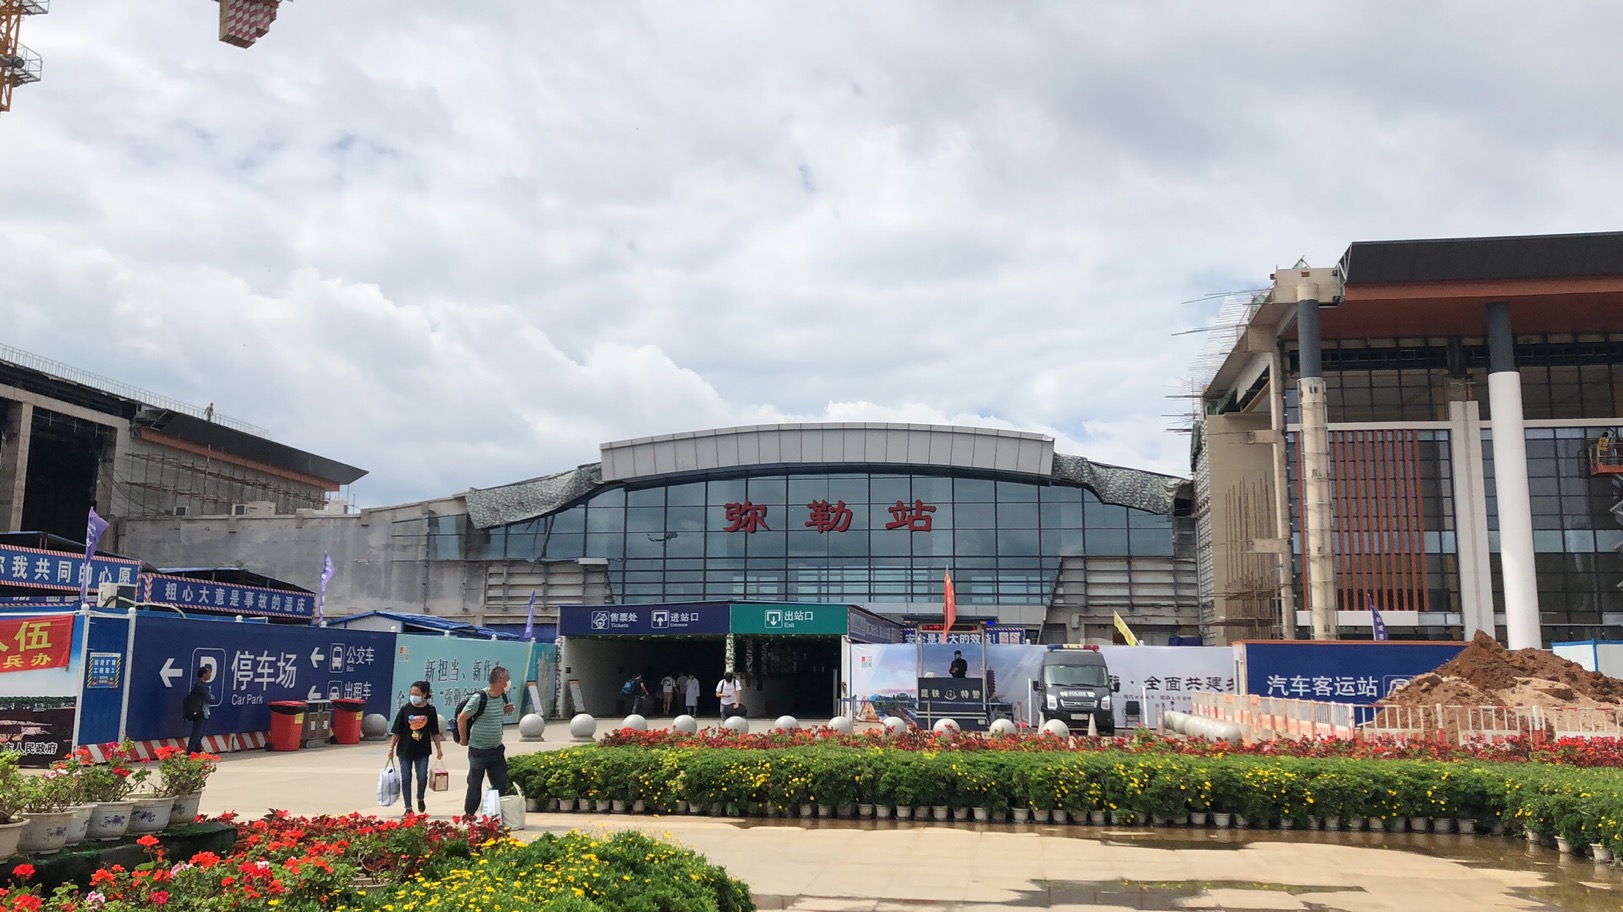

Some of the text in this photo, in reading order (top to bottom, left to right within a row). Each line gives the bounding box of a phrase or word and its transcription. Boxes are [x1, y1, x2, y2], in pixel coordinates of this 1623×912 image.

[722, 500, 937, 534] 弥勒站
[165, 581, 306, 613] 粗心大意是事故的温床
[611, 612, 637, 622] 售票处
[670, 612, 699, 622] 进站口
[784, 611, 814, 622] 出站口
[3, 653, 52, 669] 兵办
[346, 646, 375, 665] 公交车
[231, 650, 297, 691] 停车场
[425, 659, 501, 683] 新担当、新作
[344, 681, 372, 700] 出租车
[1266, 675, 1379, 697] 汽车客运站
[231, 693, 263, 705] Car Park
